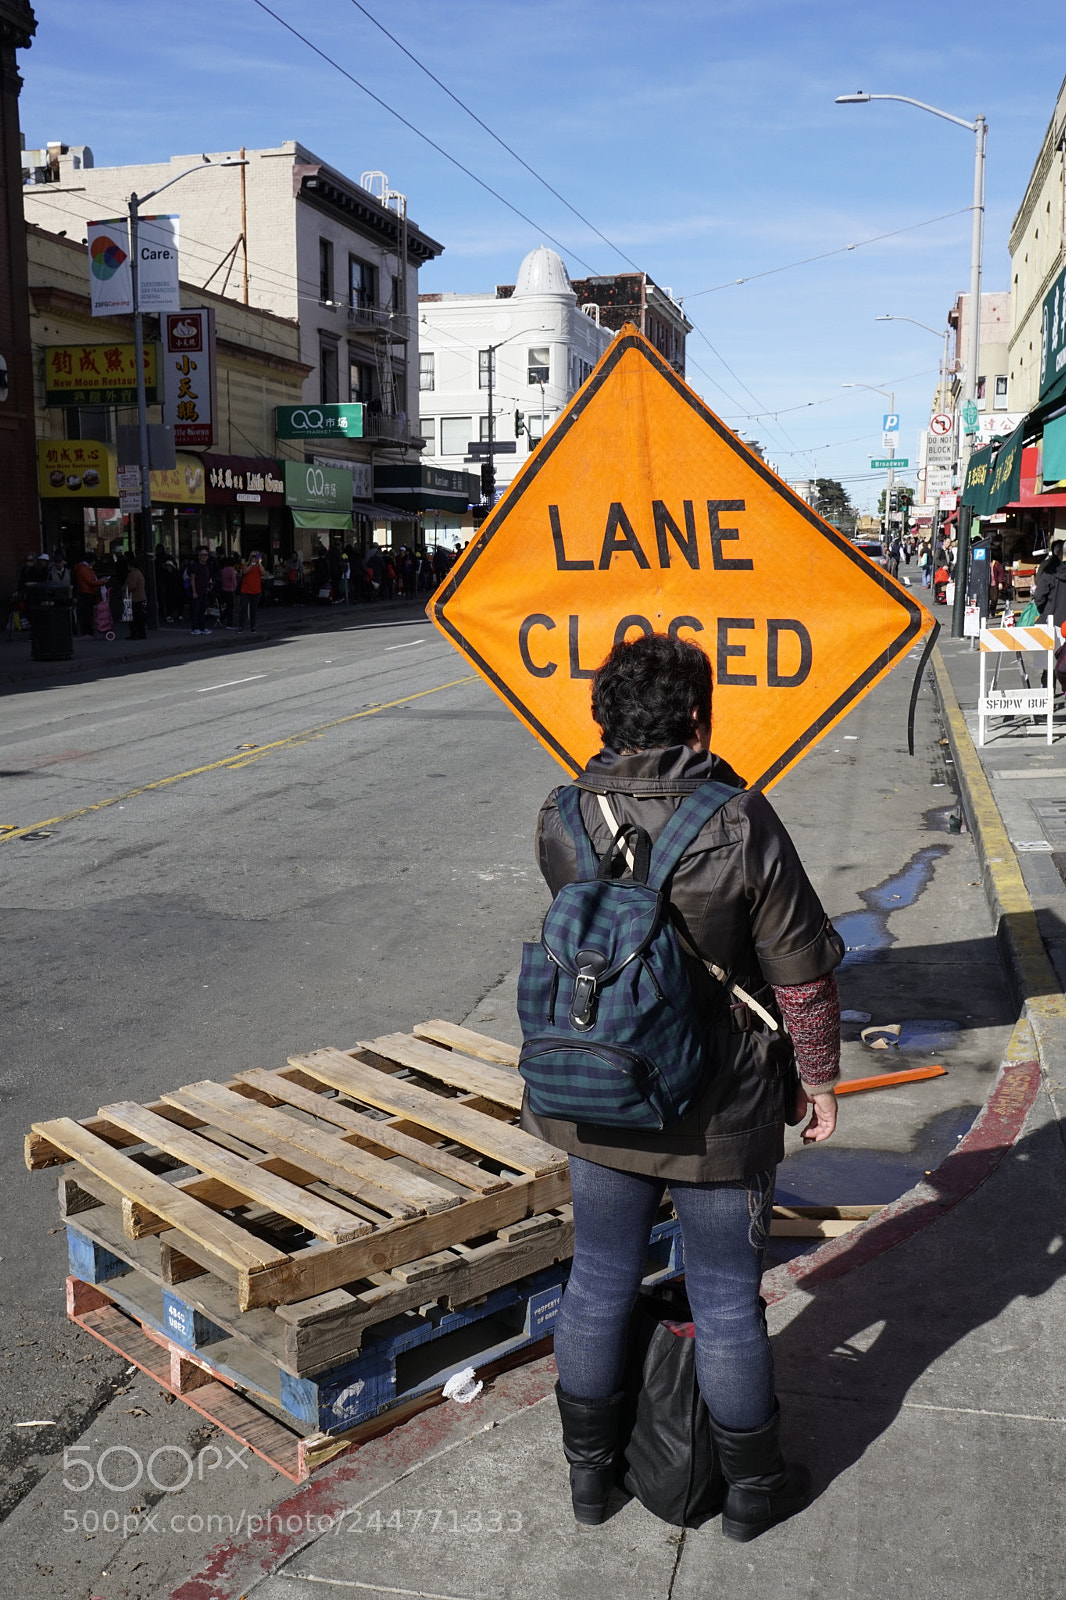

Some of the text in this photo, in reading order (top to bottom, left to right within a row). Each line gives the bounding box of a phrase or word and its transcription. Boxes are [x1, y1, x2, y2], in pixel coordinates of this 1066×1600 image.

[141, 247, 174, 260] Care.
[53, 376, 151, 387] New Moon Restaurnt
[175, 354, 199, 422] 小天鵝
[928, 446, 951, 454] BLOCK
[548, 499, 754, 571] LANE
[986, 698, 1049, 709] SFDPW BUF
[534, 1297, 561, 1316] PROPERTY
